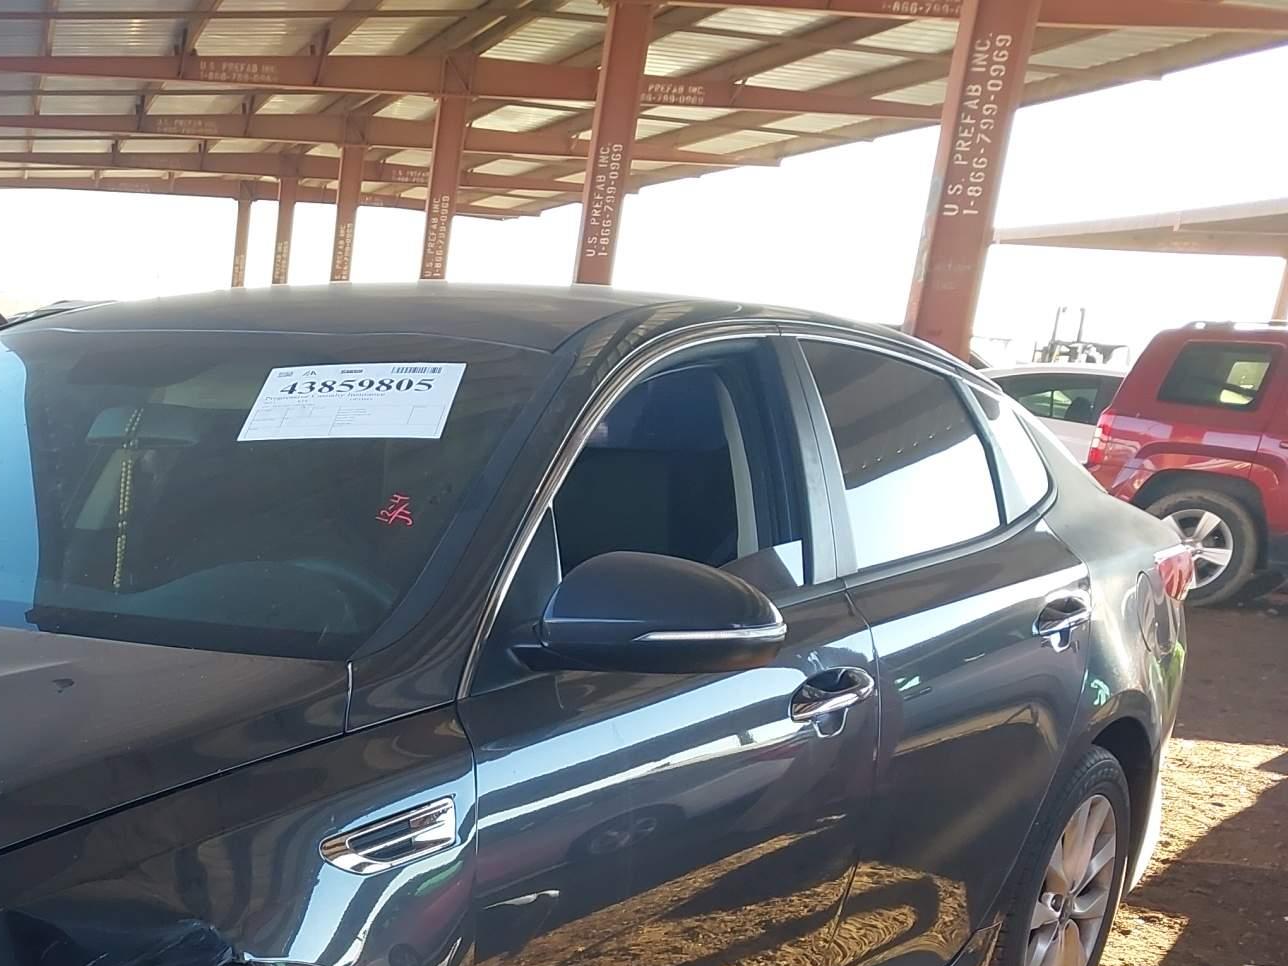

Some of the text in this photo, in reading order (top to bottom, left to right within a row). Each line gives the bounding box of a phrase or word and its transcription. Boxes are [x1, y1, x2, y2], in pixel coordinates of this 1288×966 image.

[648, 84, 685, 94] PREFAB
[954, 84, 982, 165] PREFAB
[971, 33, 994, 72] INC.
[963, 34, 1013, 215] 1-866-799-0969
[427, 217, 439, 254] PREFAB
[586, 143, 612, 257] U.S. PREFAB INC.
[598, 144, 624, 256] 1-866-799-0969
[280, 378, 435, 394] 43859805
